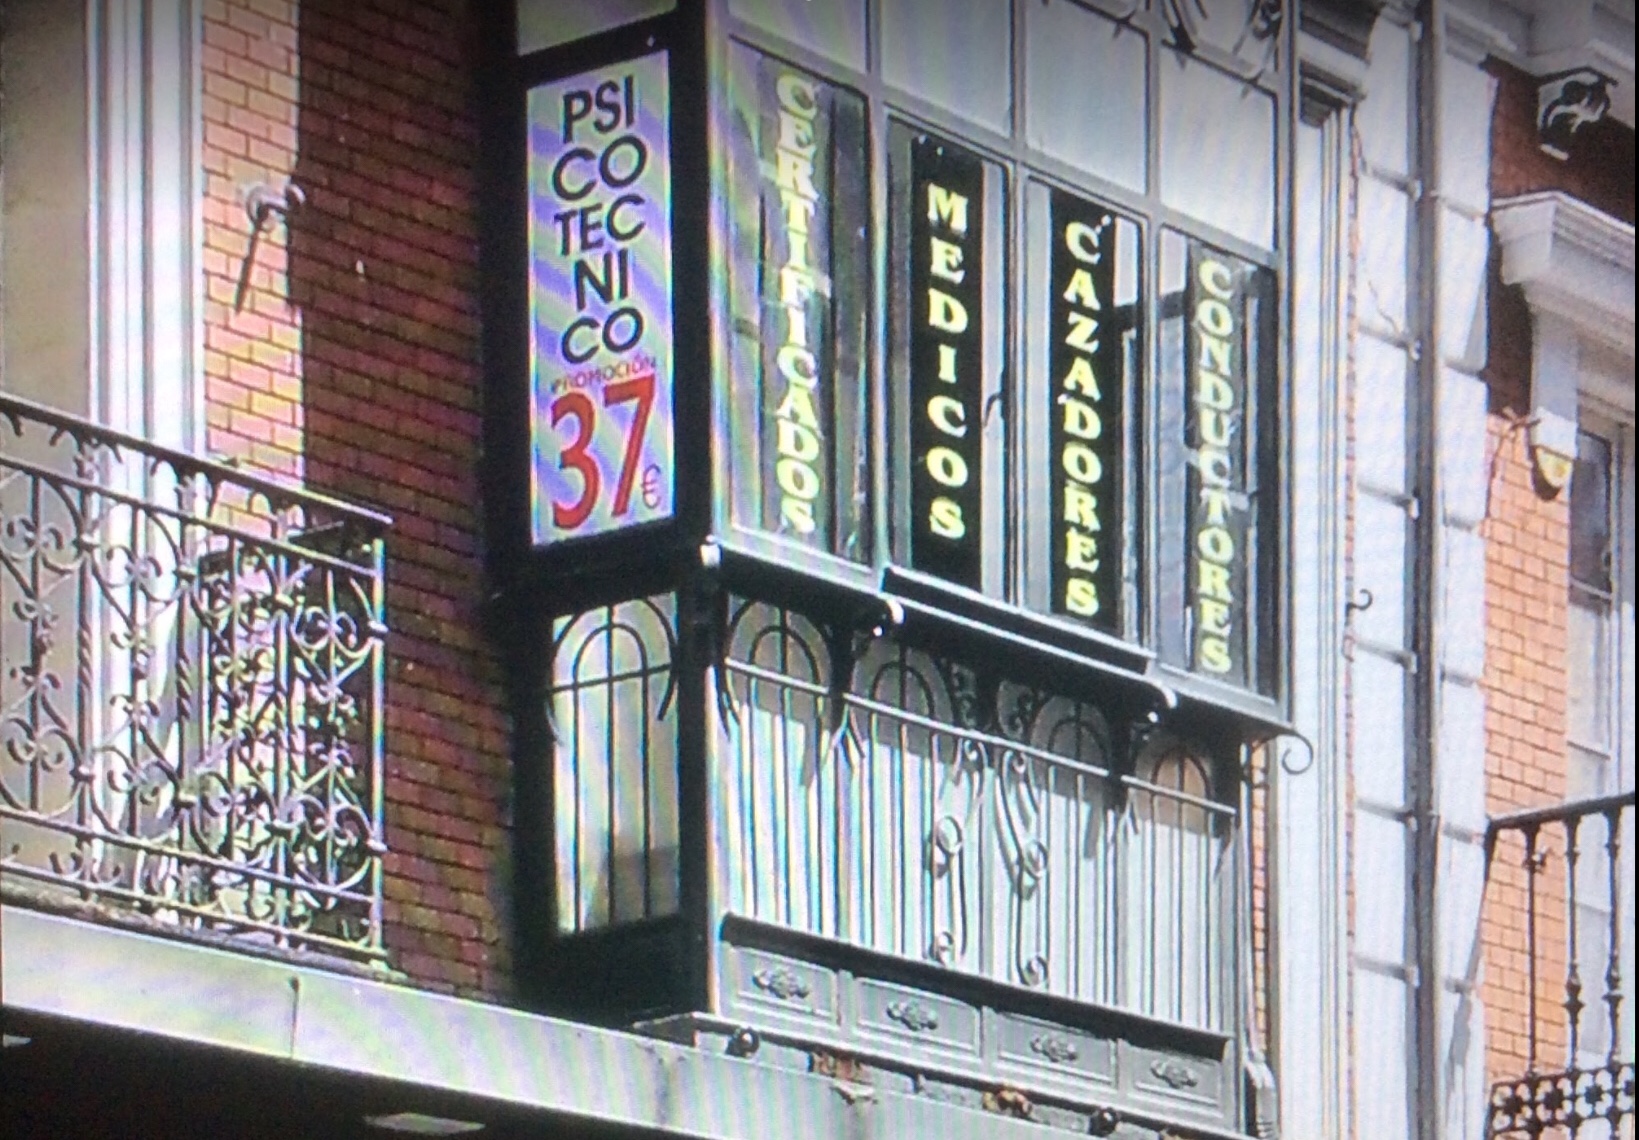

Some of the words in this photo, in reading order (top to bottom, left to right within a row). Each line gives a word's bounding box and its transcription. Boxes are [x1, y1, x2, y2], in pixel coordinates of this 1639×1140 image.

[562, 74, 635, 143] PSI
[551, 135, 648, 201] CO
[553, 194, 646, 256] TEC
[573, 248, 629, 312] NI
[775, 72, 822, 534] CERTIFICADOS
[561, 307, 644, 364] CO
[926, 182, 969, 540] MEDICOS
[1062, 221, 1102, 617] CAZADORES
[1197, 259, 1235, 674] CONDUCTORES
